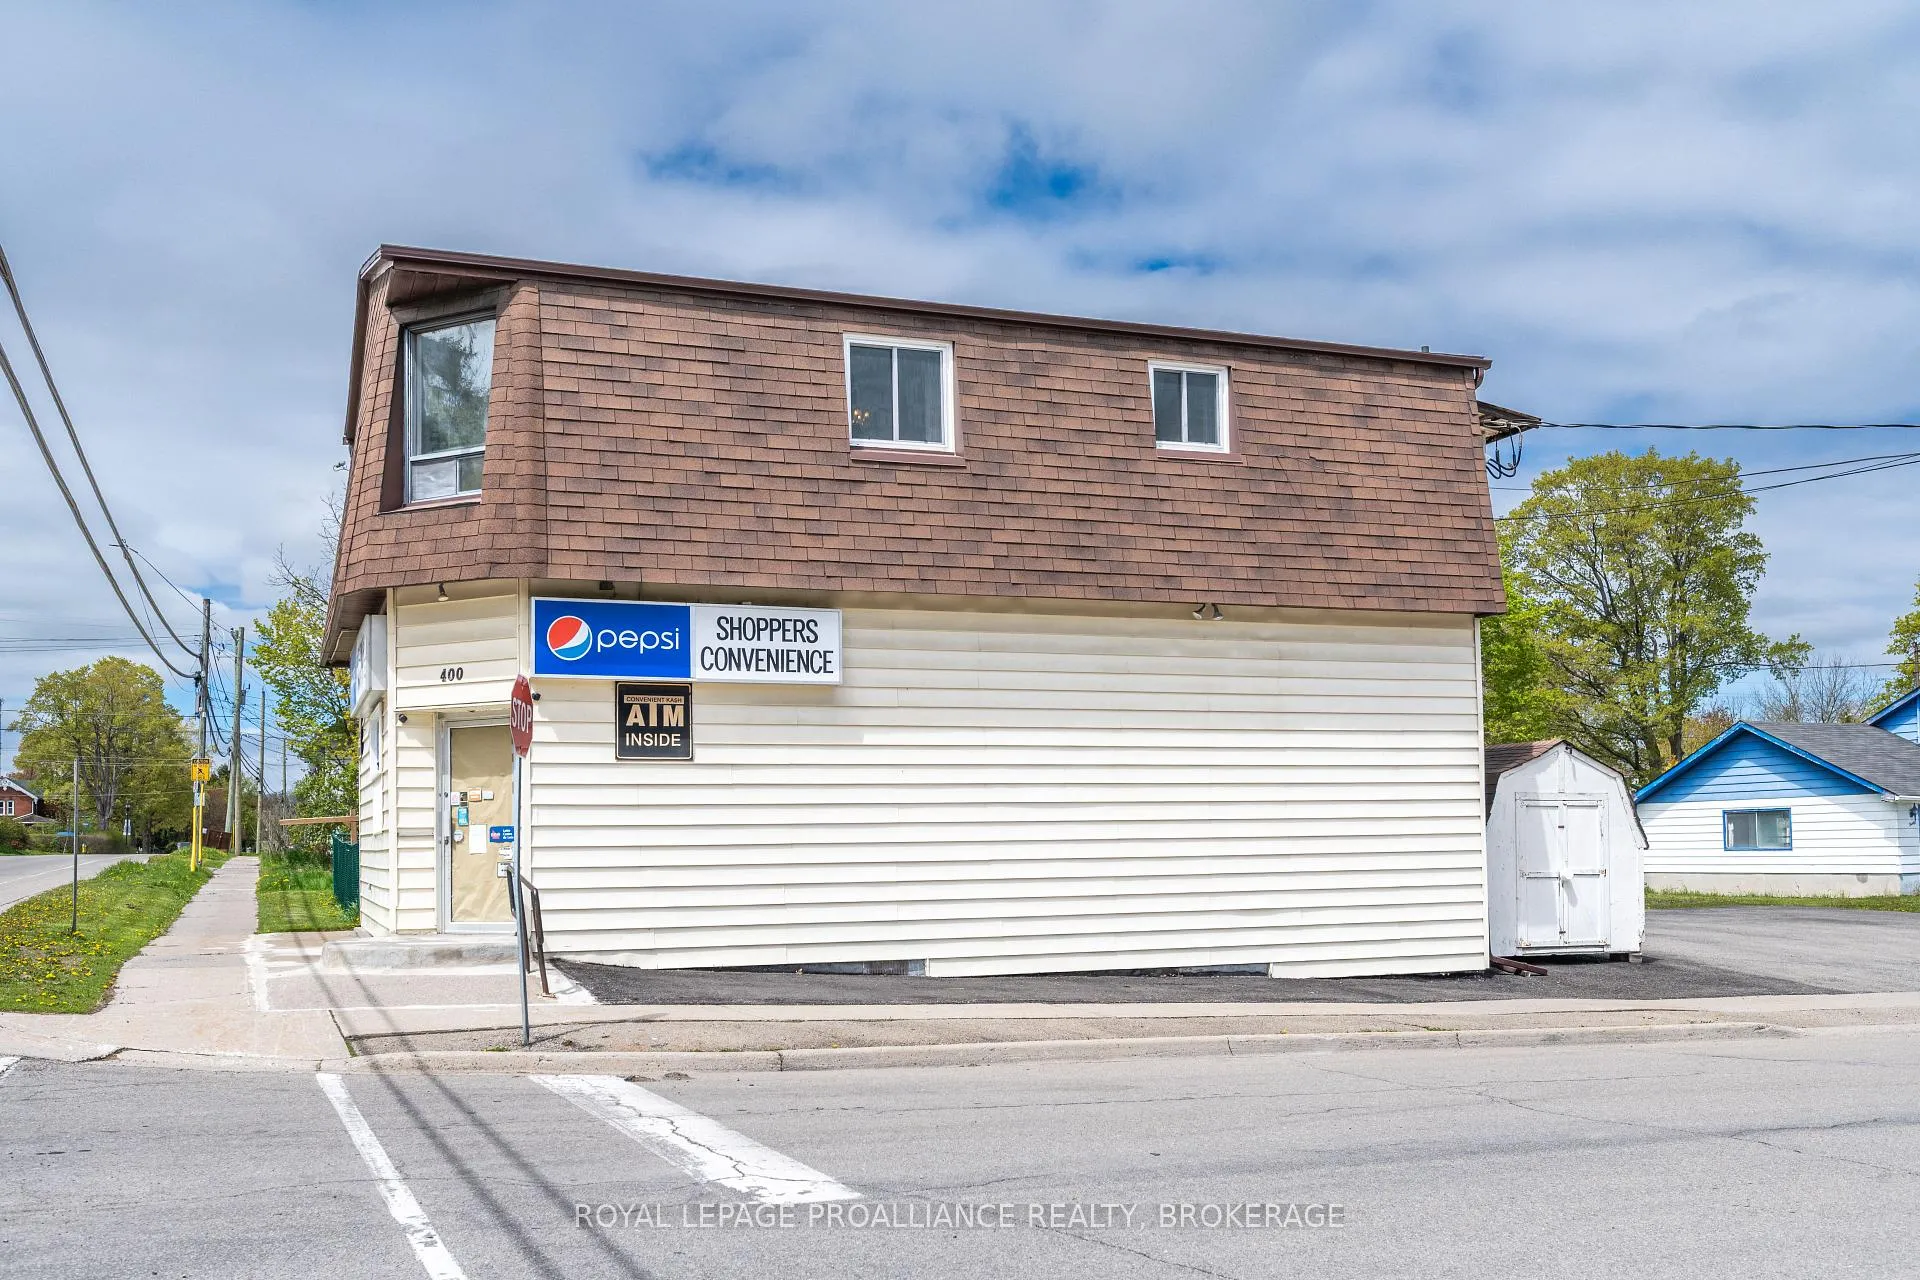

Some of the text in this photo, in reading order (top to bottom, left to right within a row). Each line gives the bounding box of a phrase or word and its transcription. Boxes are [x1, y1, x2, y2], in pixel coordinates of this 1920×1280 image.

[597, 627, 680, 654] pepsi
[716, 615, 819, 643] SHOPPERS
[700, 646, 834, 673] CONVENIENCE
[440, 667, 463, 682] 400
[512, 697, 532, 733] STOP
[625, 704, 684, 727] ATM
[625, 733, 681, 747] INSIDE
